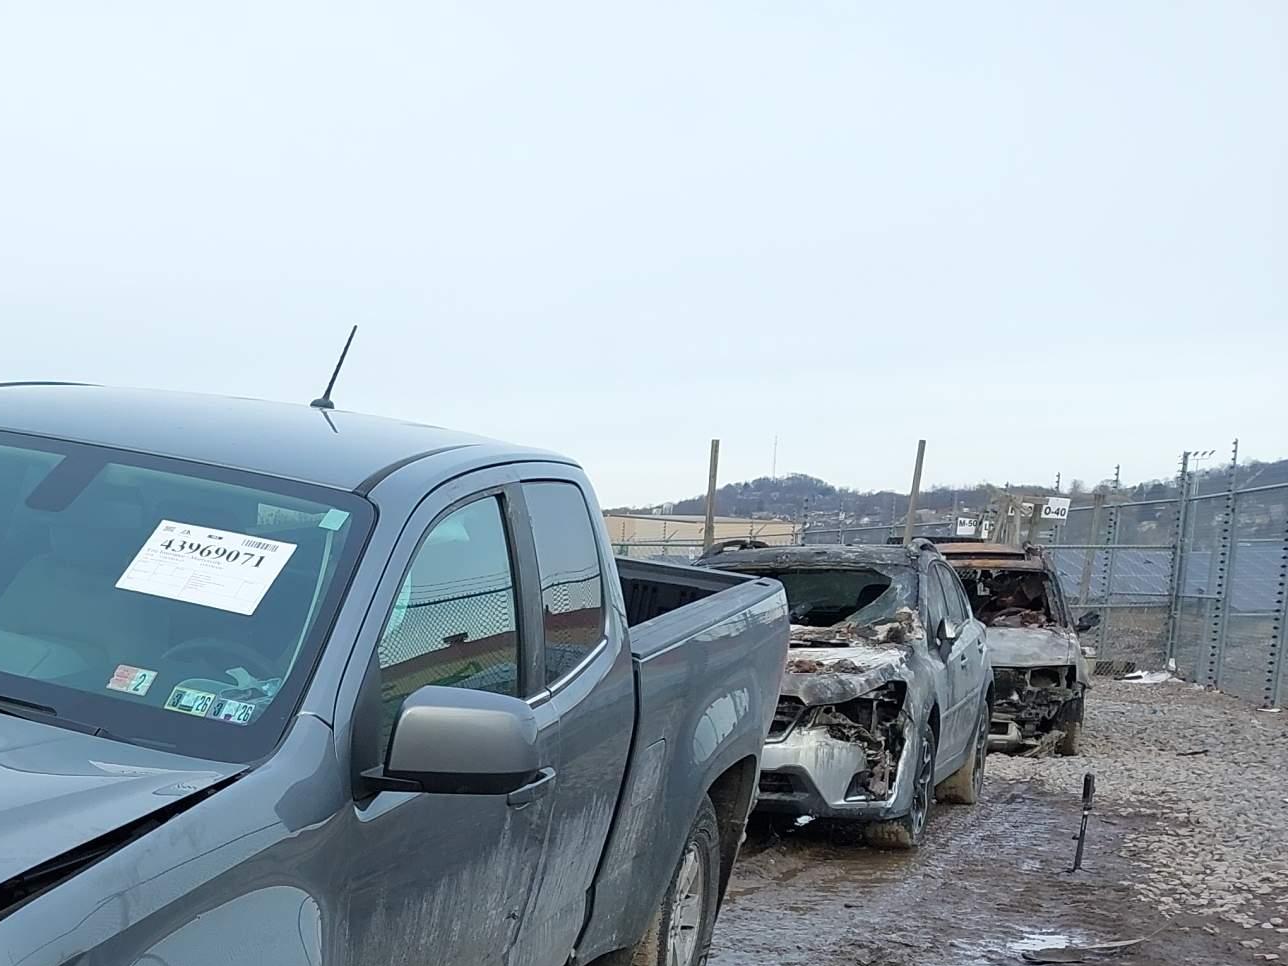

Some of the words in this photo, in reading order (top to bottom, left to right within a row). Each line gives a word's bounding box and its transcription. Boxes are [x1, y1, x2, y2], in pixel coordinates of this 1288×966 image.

[1044, 506, 1067, 517] O-40
[958, 519, 978, 528] M-50
[160, 538, 265, 568] 43969071
[132, 673, 147, 692] 2
[172, 693, 182, 708] 3
[195, 695, 212, 713] 26
[213, 702, 224, 717] 3
[237, 704, 253, 722] 26
